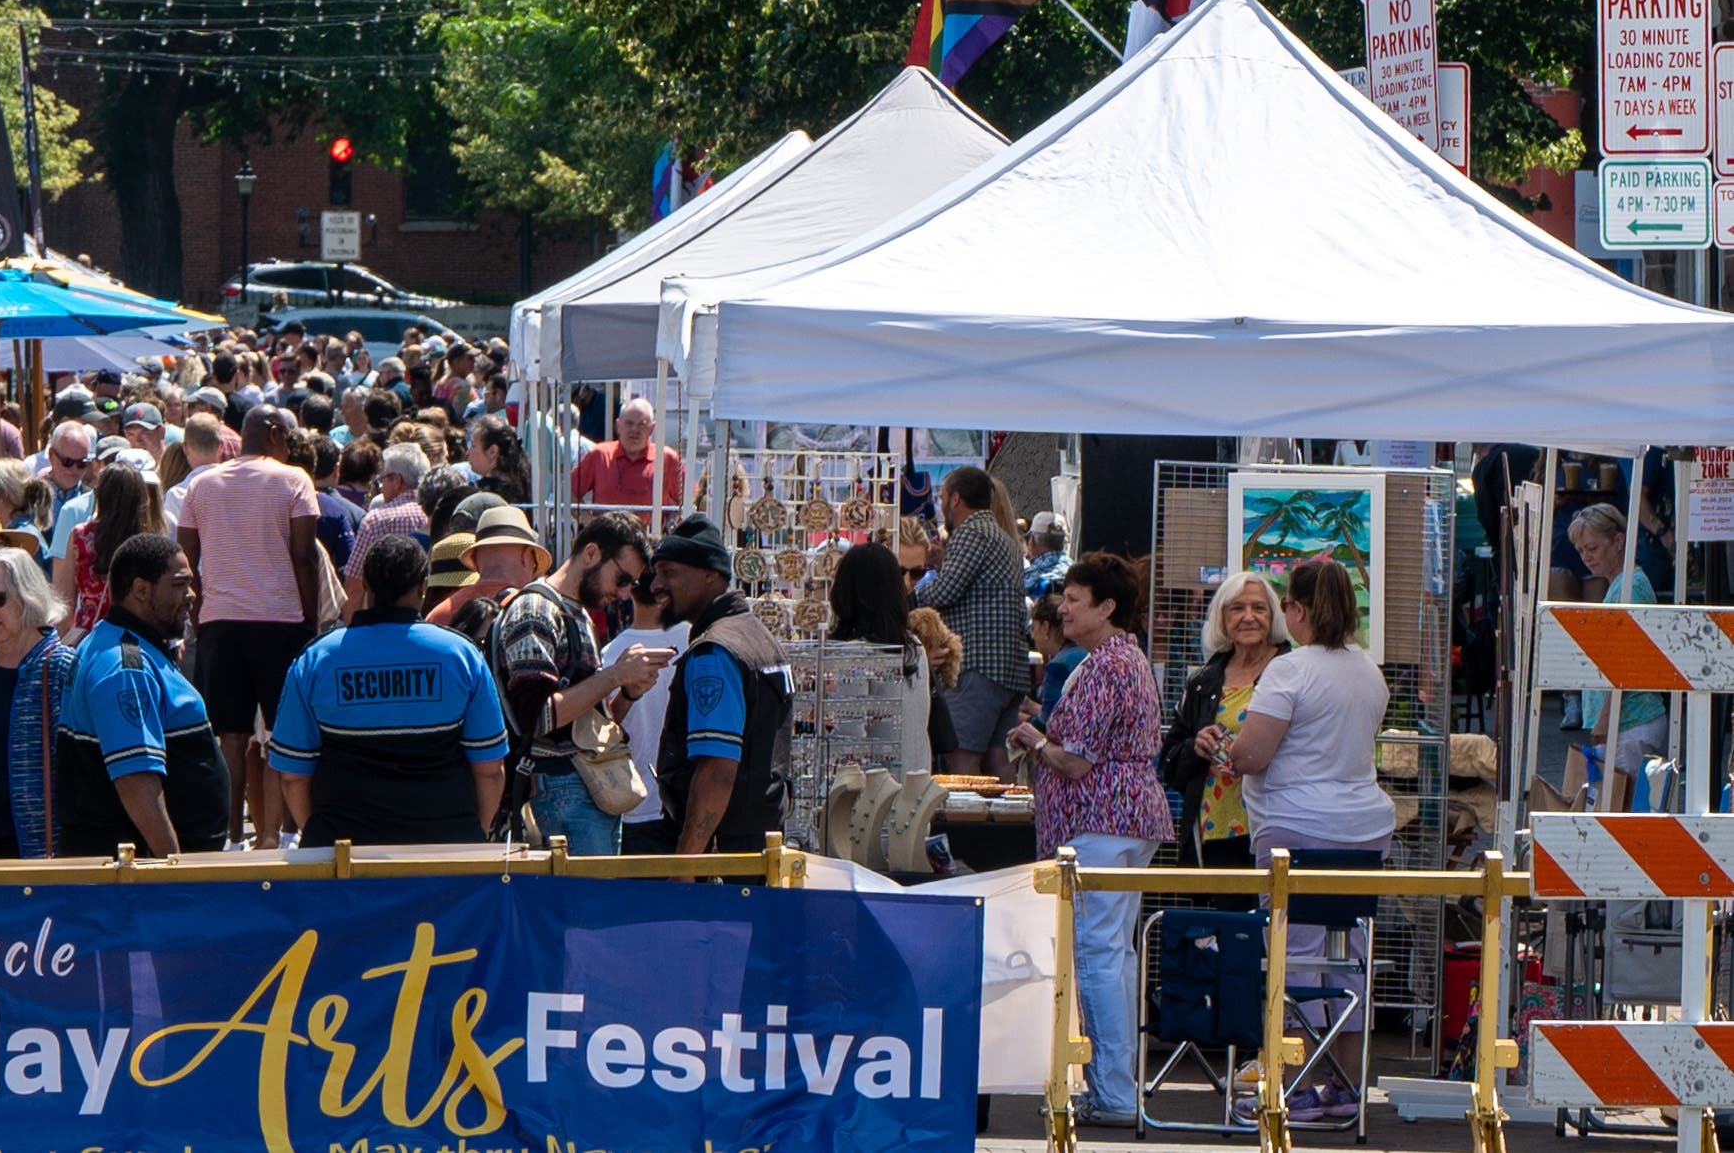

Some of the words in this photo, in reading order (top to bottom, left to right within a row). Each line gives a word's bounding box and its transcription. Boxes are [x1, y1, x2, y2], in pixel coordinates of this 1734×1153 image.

[1373, 25, 1431, 61] PARKING
[1620, 29, 1636, 46] 30
[1643, 29, 1689, 45] MINUTE
[1381, 65, 1392, 79] 30
[1395, 59, 1424, 76] MINUTE
[1608, 52, 1663, 69] LOADING
[1668, 52, 1702, 68] ZONE
[1374, 79, 1409, 99] LOADING
[1412, 75, 1432, 90] ZONE
[1618, 76, 1646, 92] 7AM
[1662, 76, 1691, 91] 4PM
[1408, 95, 1427, 109] 4PM
[1614, 100, 1620, 116] 7
[1624, 100, 1654, 115] DAYS
[1658, 100, 1666, 115] A
[1668, 99, 1696, 114] WEEK
[1412, 111, 1431, 125] WEEK
[1610, 171, 1640, 188] PAID
[1646, 171, 1701, 188] PARKING
[1628, 197, 1643, 212] PM
[1654, 197, 1678, 212] 7:30
[1681, 196, 1695, 212] PM
[1701, 463, 1730, 479] ZONE
[341, 668, 436, 701] SECURITY
[129, 922, 525, 1153] Arts
[525, 991, 942, 1100] Festival
